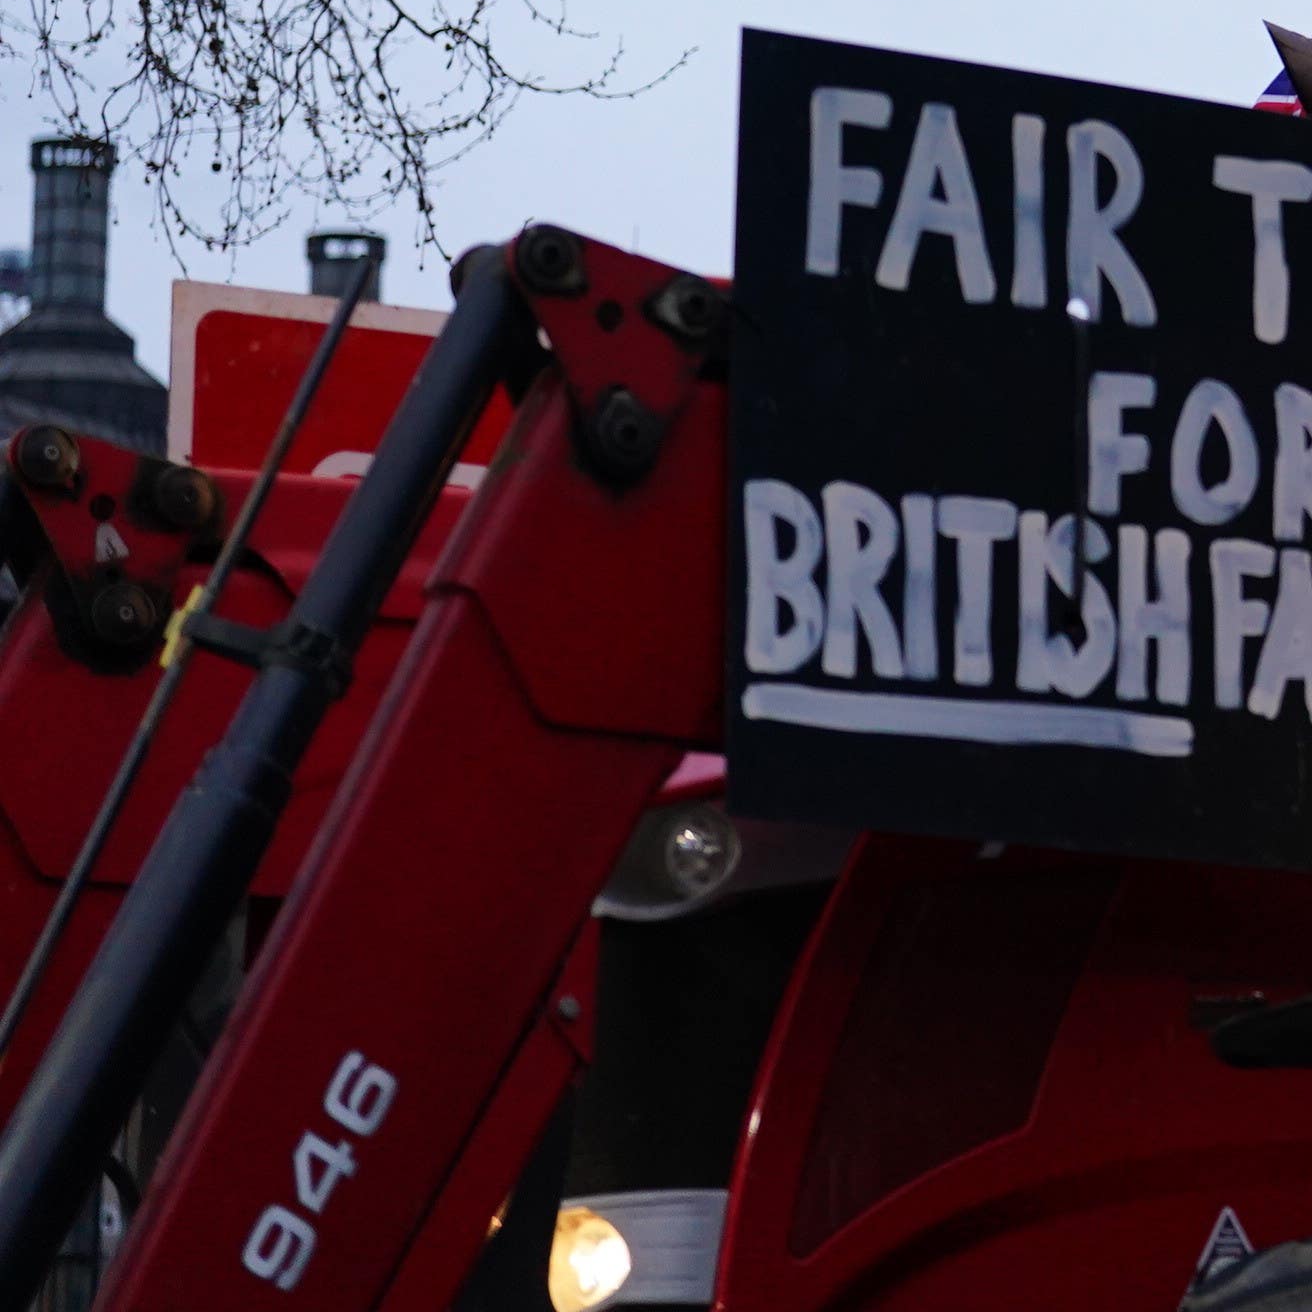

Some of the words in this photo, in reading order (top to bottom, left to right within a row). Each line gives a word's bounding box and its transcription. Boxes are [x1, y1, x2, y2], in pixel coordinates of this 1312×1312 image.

[805, 87, 1158, 327] FAIR
[743, 478, 1191, 706] BRITISH
[243, 1050, 398, 1291] 946
